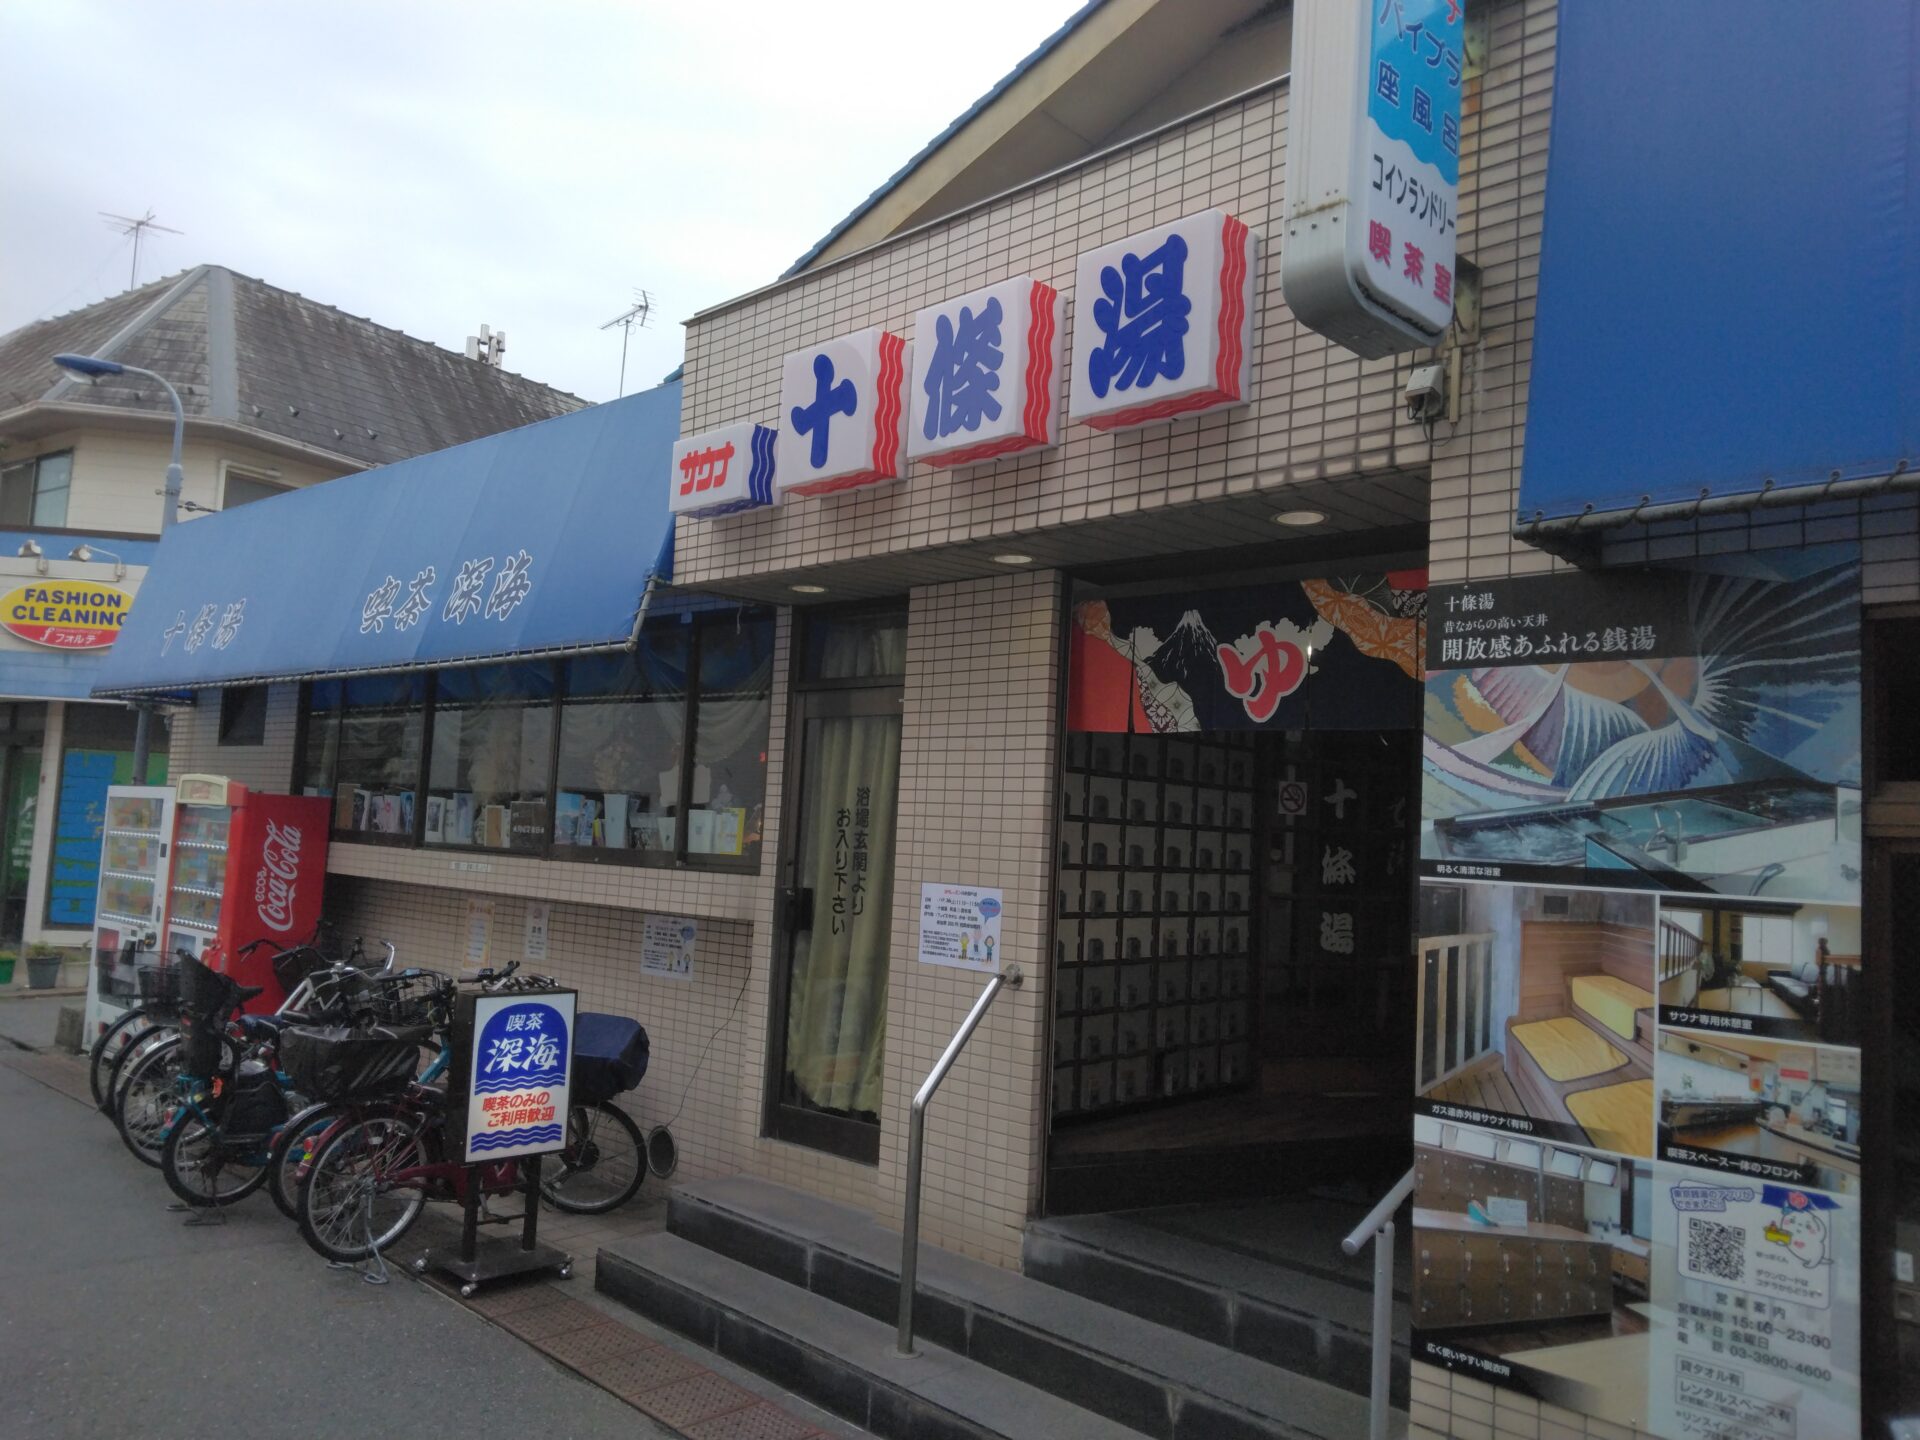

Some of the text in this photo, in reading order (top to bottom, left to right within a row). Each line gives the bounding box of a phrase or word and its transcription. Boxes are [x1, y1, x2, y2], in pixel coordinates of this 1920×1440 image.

[1377, 59, 1458, 156] 座風呂
[1372, 153, 1454, 235] コインランドリー
[1369, 219, 1451, 306] 喫茶室
[679, 441, 735, 496] サウナ
[24, 588, 121, 608] FASHION
[360, 549, 533, 634] 喫茶 深海
[1444, 592, 1495, 613] 十條湯
[55, 633, 97, 645] フォルテ
[1444, 613, 1549, 634] 昔ながらの高い天井
[1442, 625, 1657, 663] 開放感あふれる銭湯
[1216, 629, 1305, 723] ゆ
[832, 808, 850, 936] お入り下さい
[1437, 864, 1501, 877] 明るく清潔な浴室
[506, 1012, 545, 1032] 喫茶
[1669, 1011, 1753, 1030] サウナ専用休憩室
[484, 1033, 560, 1073] 深海
[482, 1091, 550, 1112] 喫茶のみの
[488, 1106, 555, 1128] ご利用歓迎
[1667, 1147, 1803, 1180] 喫茶スペース一体のフロント
[1427, 1342, 1511, 1377] 広く使いやすい脱衣所
